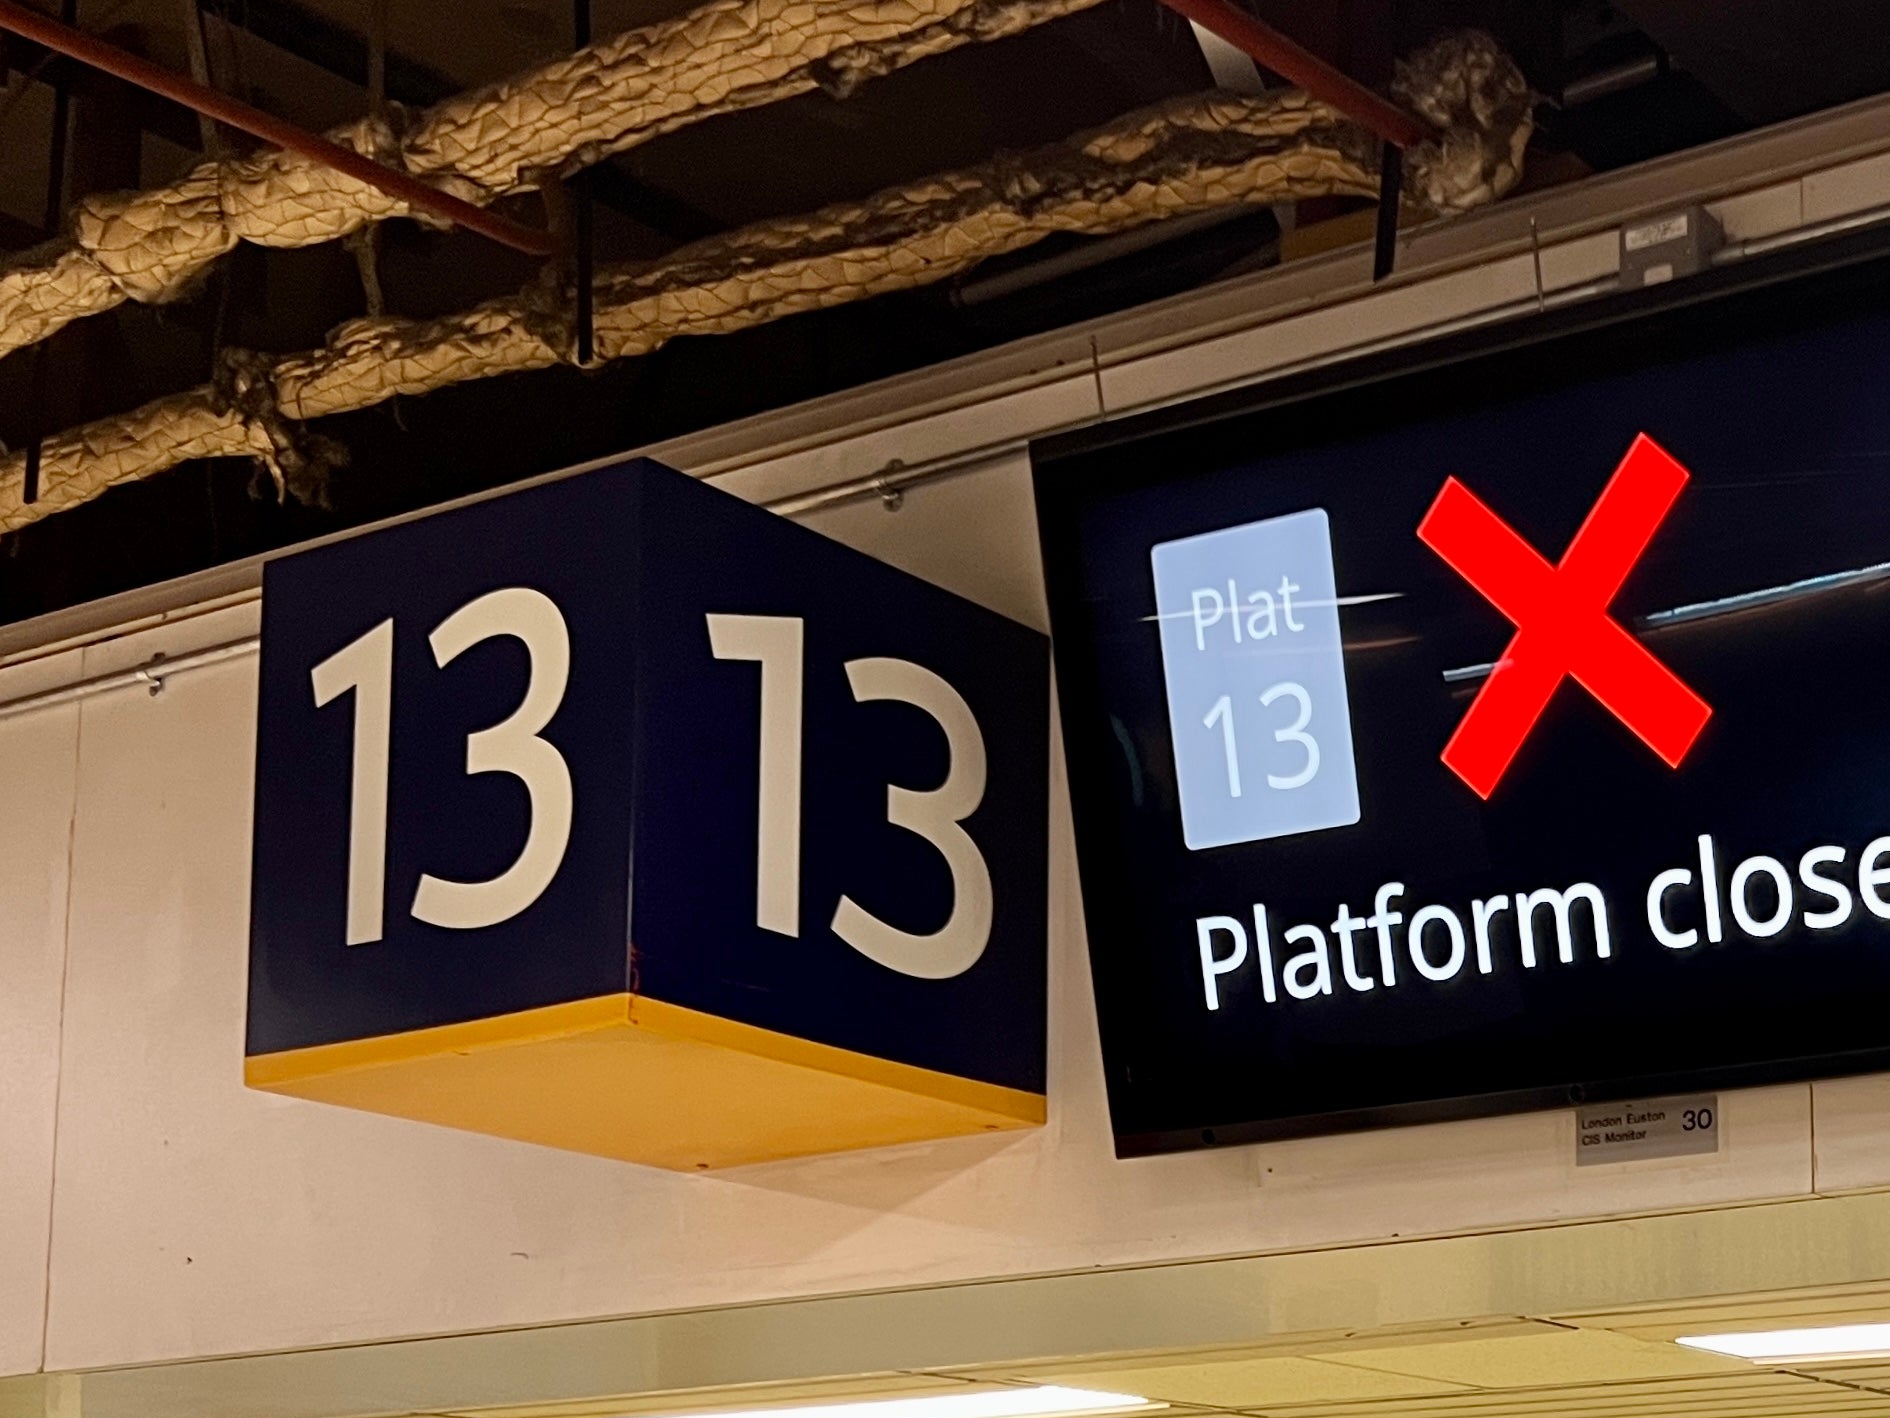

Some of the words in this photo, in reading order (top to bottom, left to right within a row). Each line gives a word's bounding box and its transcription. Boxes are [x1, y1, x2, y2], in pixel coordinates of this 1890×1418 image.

[1190, 575, 1305, 652] Plat
[311, 587, 573, 946] 13
[705, 612, 994, 980] 13
[1202, 682, 1322, 799] 13
[1195, 882, 1611, 1011] Platform
[1581, 1116, 1622, 1130] London
[1626, 1111, 1666, 1125] Euston
[1682, 1108, 1713, 1132] 30
[1581, 1134, 1601, 1146] CIS
[1604, 1130, 1647, 1144] Monitor
